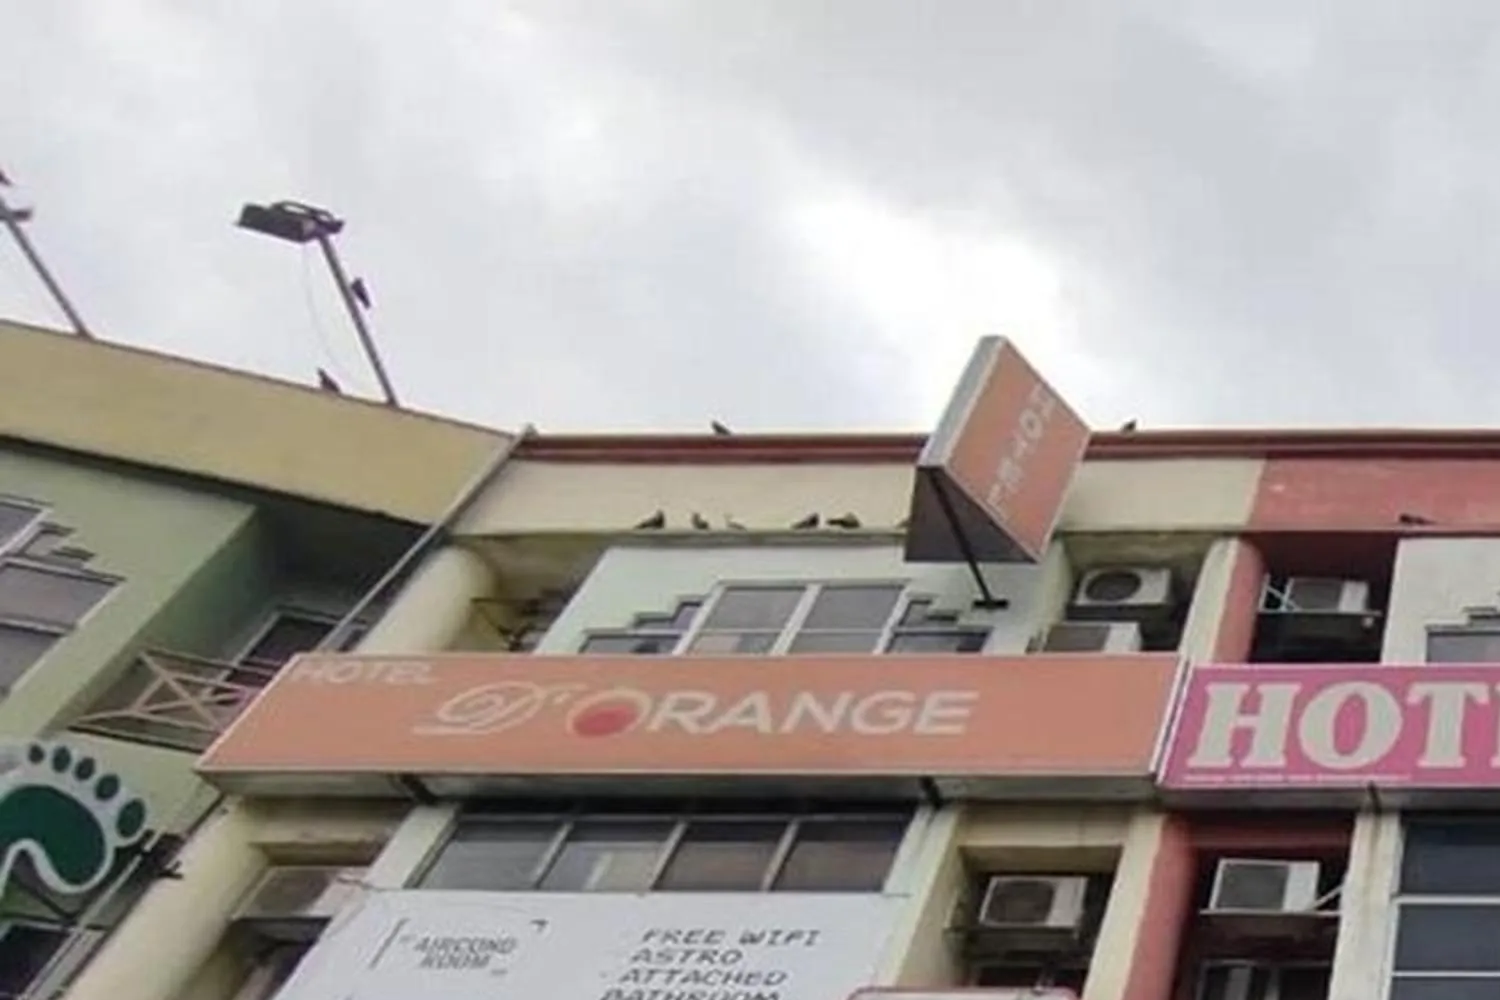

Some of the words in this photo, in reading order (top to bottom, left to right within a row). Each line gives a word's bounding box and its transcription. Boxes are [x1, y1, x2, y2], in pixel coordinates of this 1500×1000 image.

[287, 660, 434, 684] HOTEL
[641, 929, 725, 945] FREE
[737, 929, 820, 946] WIFI
[630, 948, 744, 965] ASTRO
[618, 968, 788, 986] ATTACHED
